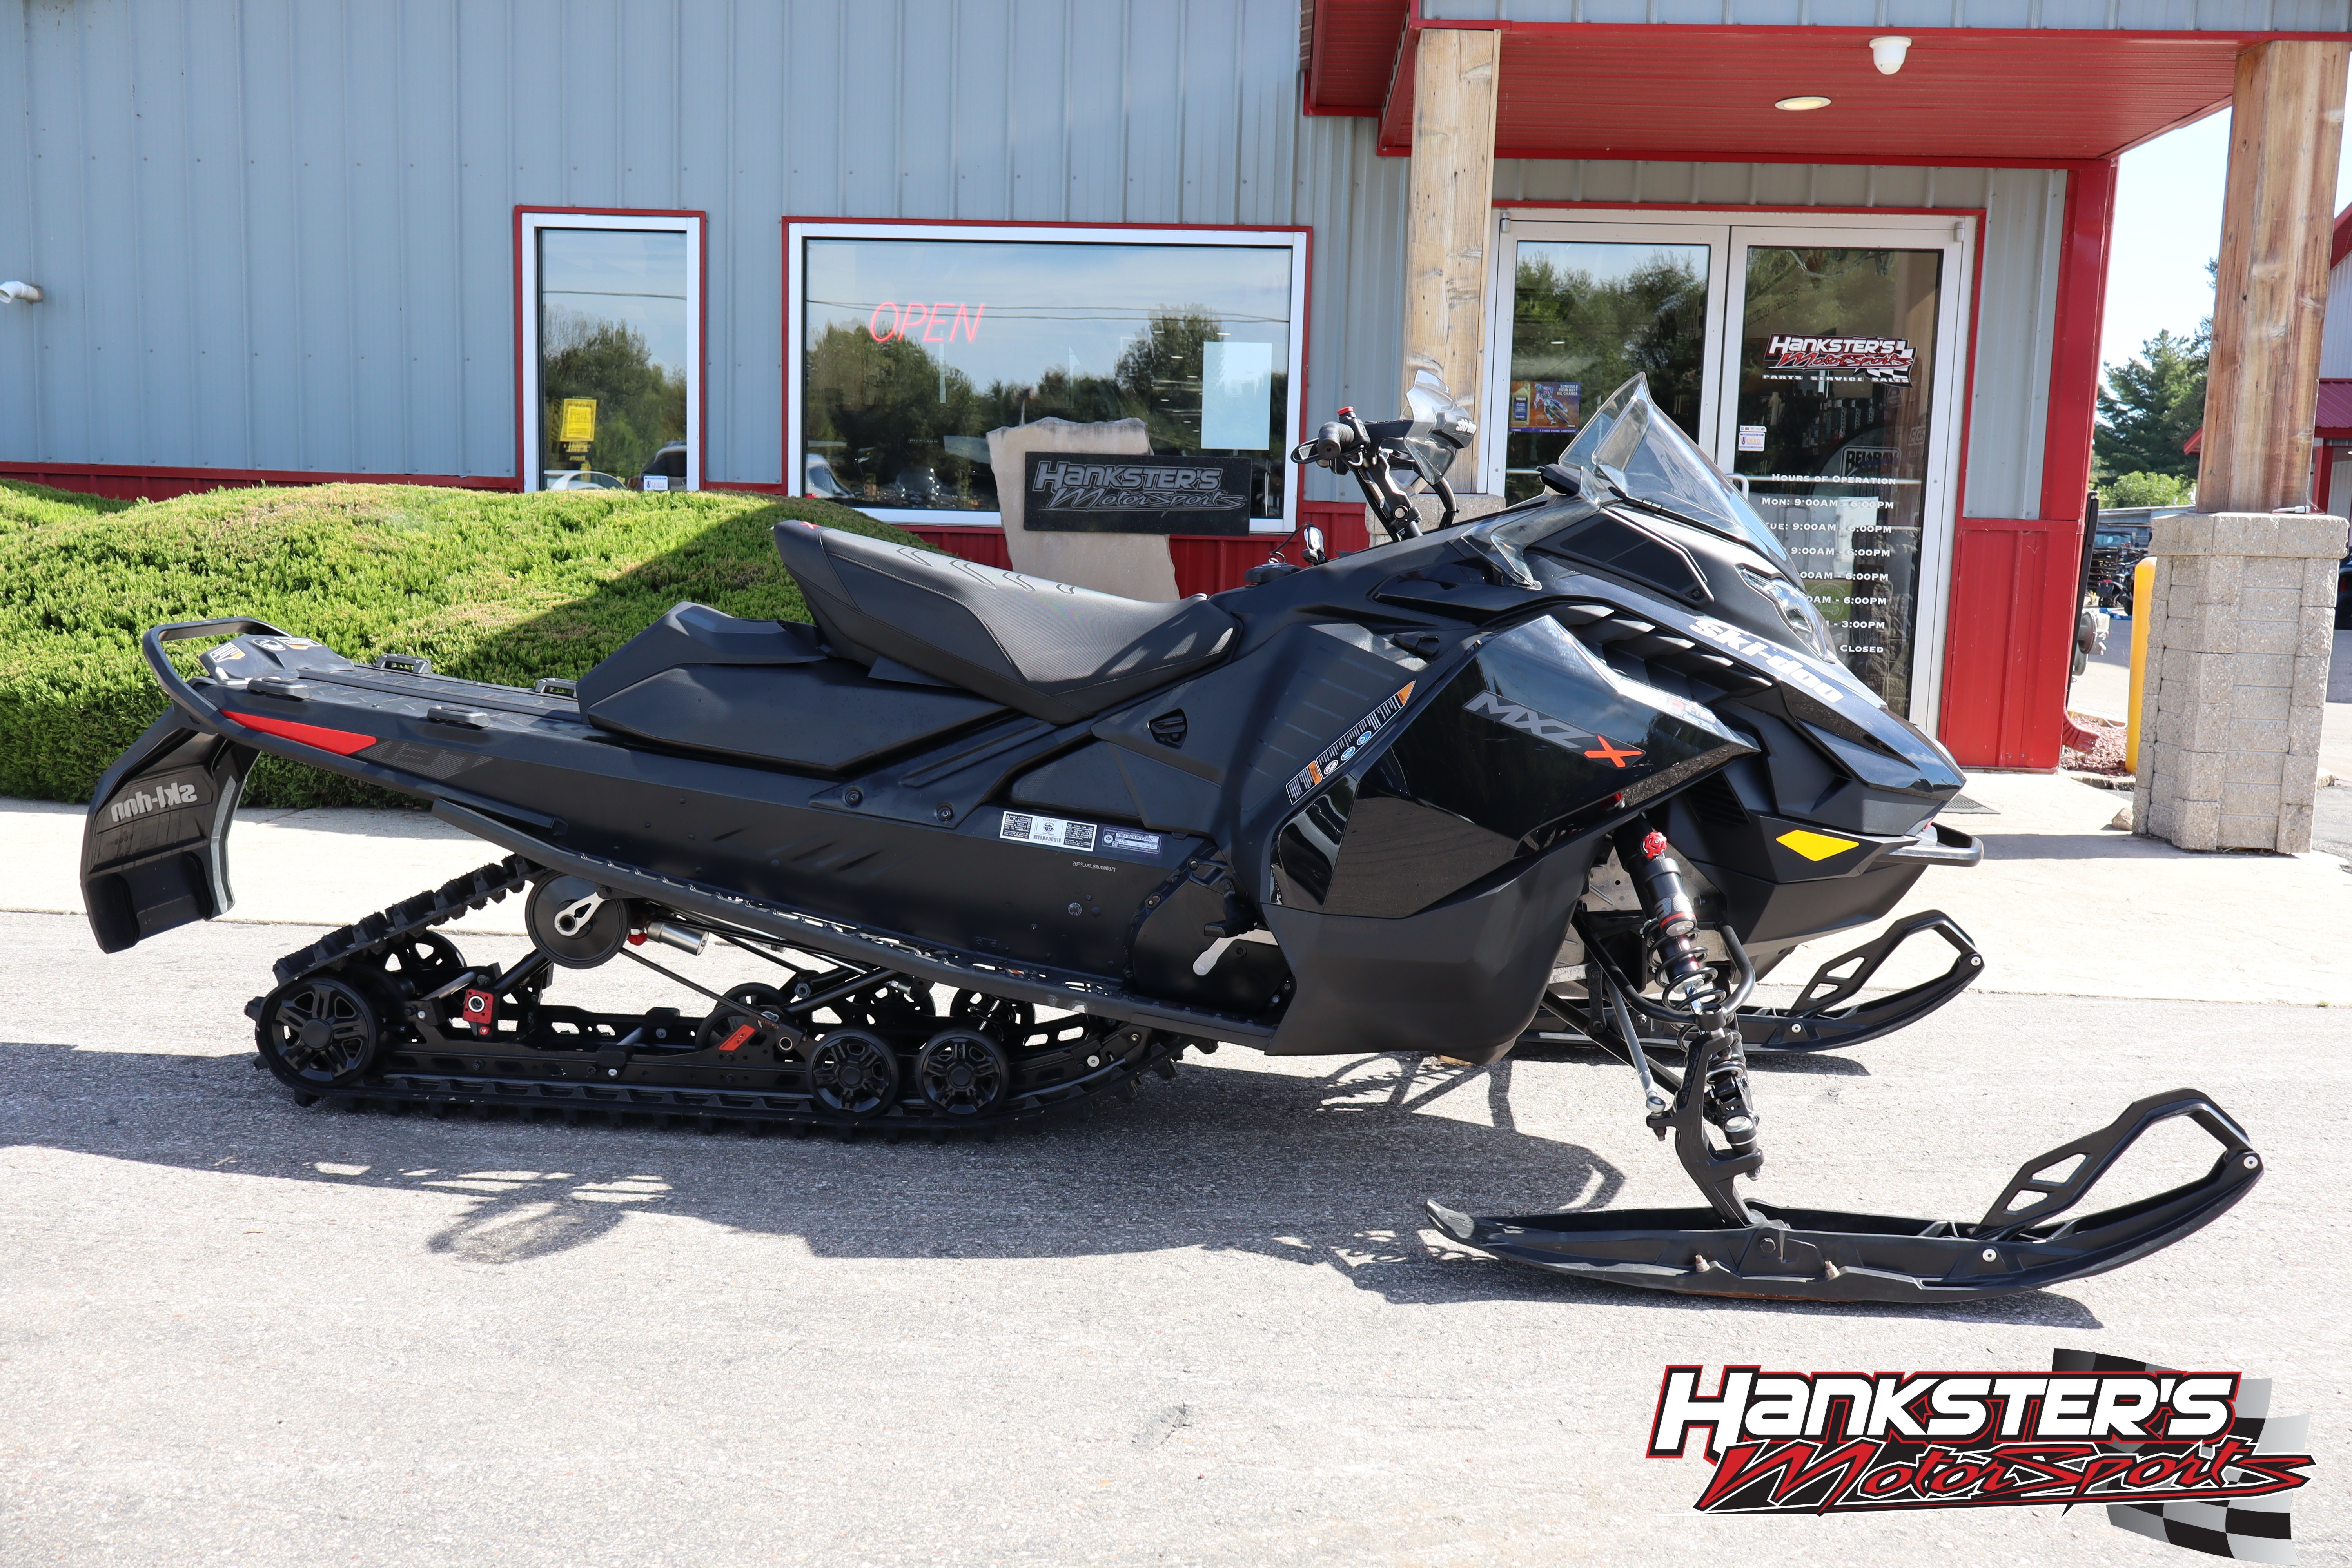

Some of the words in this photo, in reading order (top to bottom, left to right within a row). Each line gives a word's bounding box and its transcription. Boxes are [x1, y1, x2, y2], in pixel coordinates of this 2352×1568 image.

[870, 301, 984, 342] OPEN
[1850, 500, 1894, 509] 6:00PM
[1793, 523, 1837, 532] 9:00AM
[1849, 524, 1892, 534] 6:00PM
[1791, 546, 1835, 555] 9:00AM
[1847, 548, 1891, 557] 6:00PM
[1845, 572, 1889, 581] 6:00PM
[1843, 596, 1887, 606] 6:00PM
[1841, 621, 1885, 630] 3:00PM
[1840, 644, 1884, 653] CLOSED
[1686, 705, 1715, 722] E-TEC
[1467, 691, 1595, 748] MXZ
[1584, 735, 1646, 767] X
